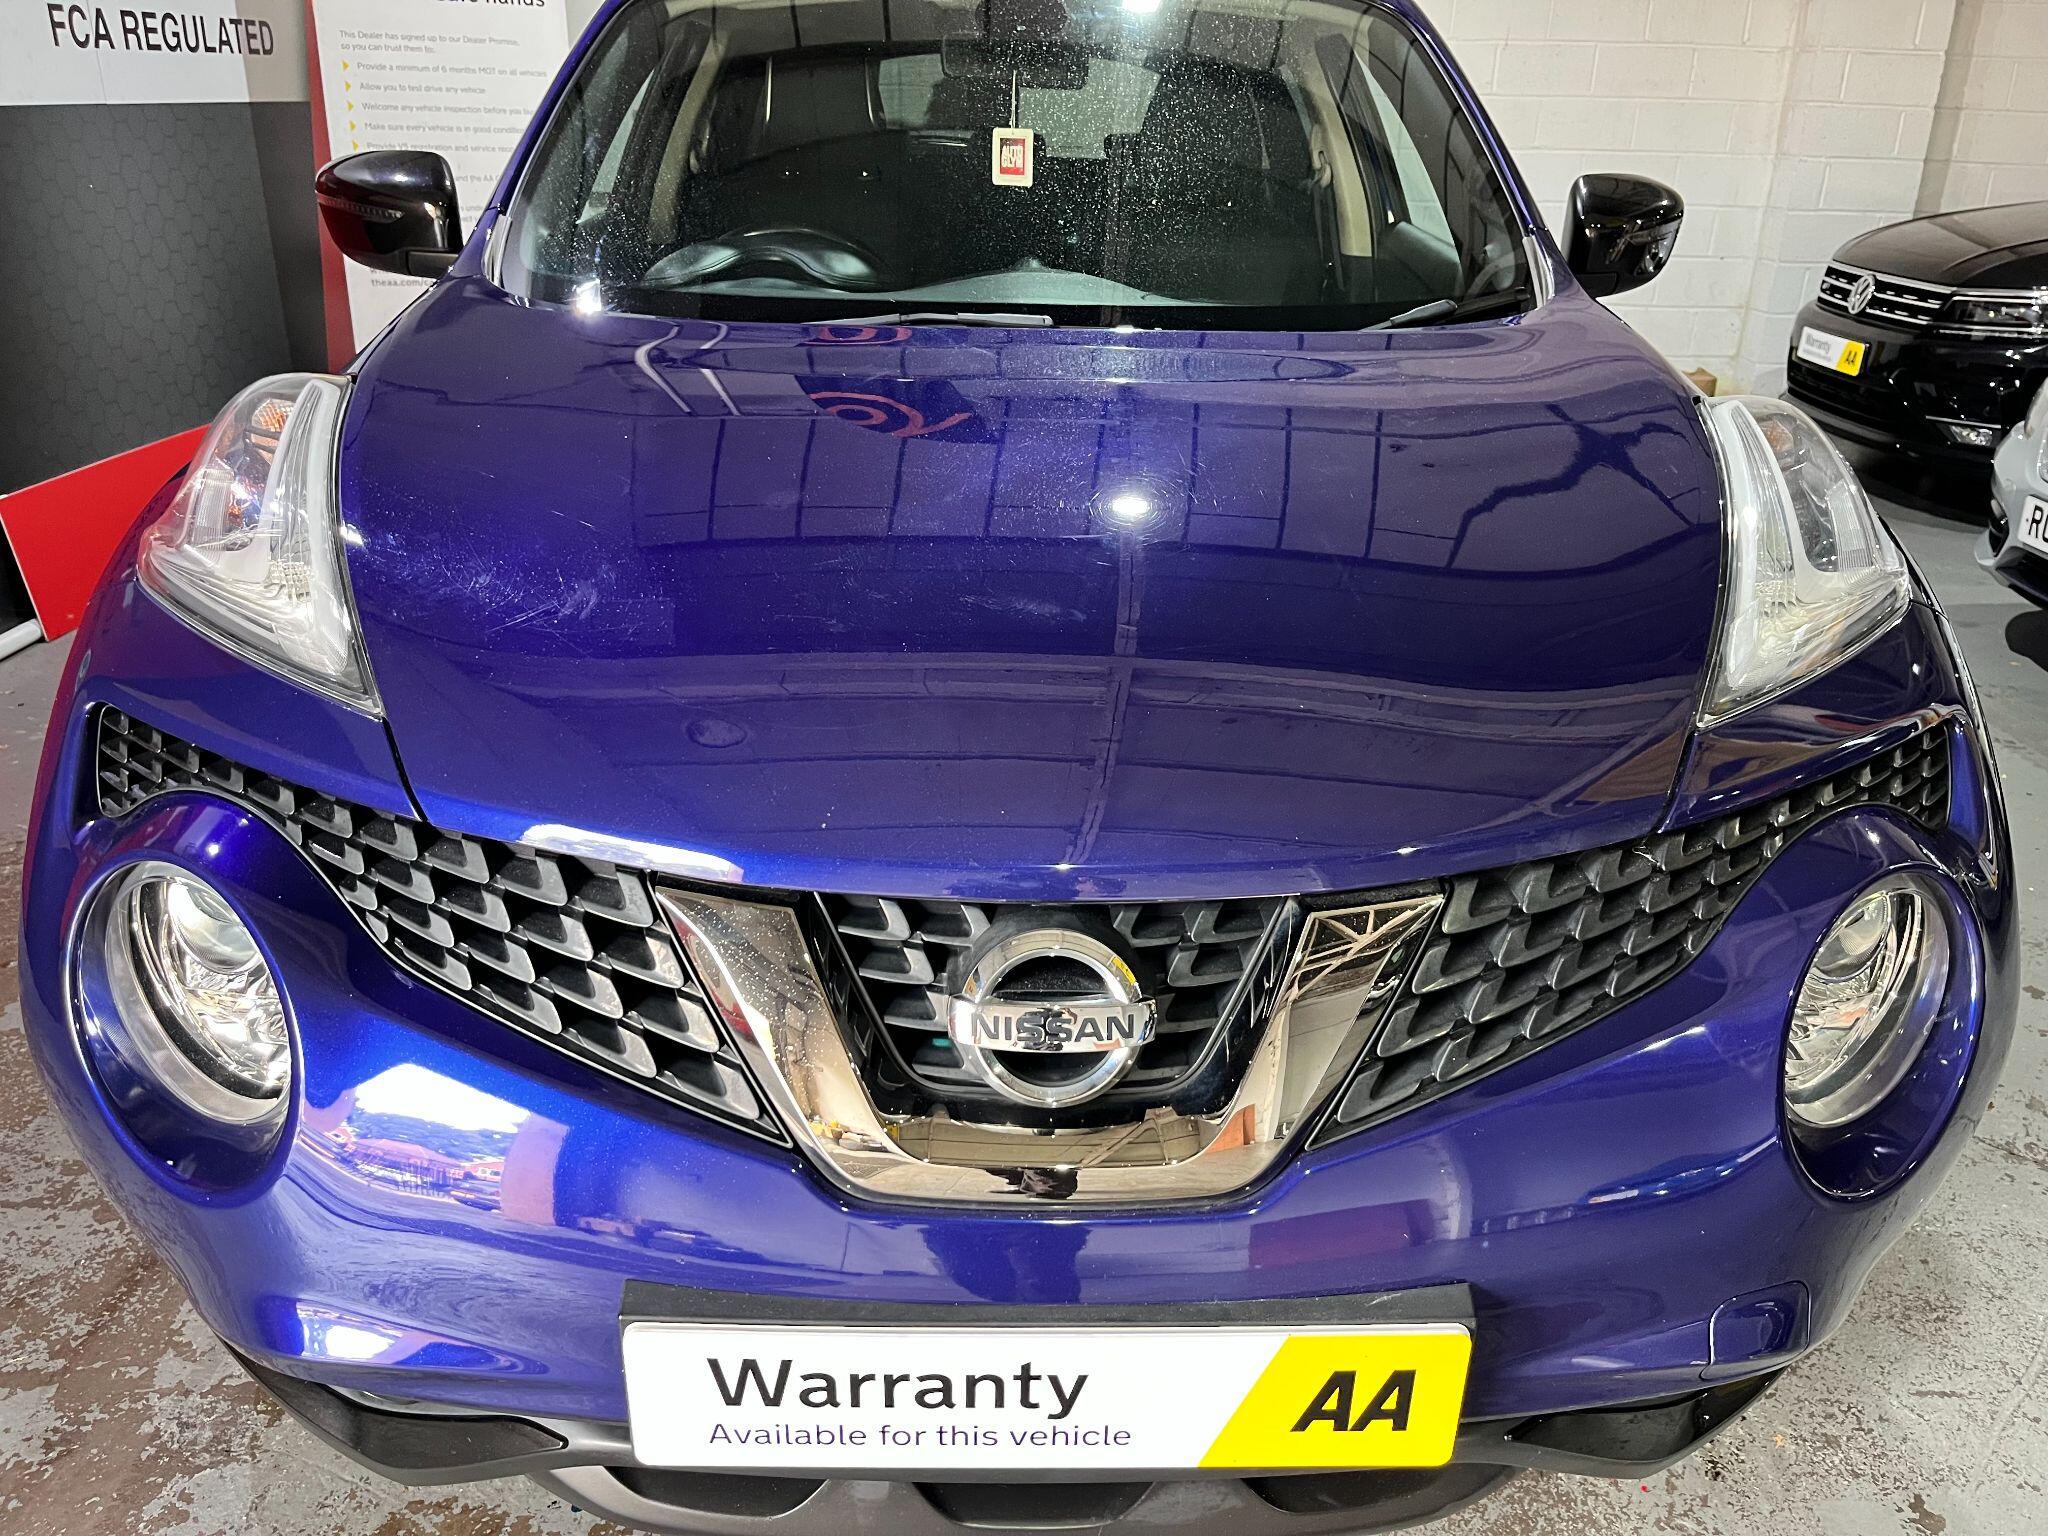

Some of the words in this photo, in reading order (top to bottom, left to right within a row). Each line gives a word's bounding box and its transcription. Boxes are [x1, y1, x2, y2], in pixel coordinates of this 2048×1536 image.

[47, 3, 115, 49] FCA
[120, 10, 274, 55] REGULATED
[339, 30, 356, 39] This
[357, 30, 383, 40] Dealer
[384, 32, 399, 40] has
[400, 33, 425, 42] signed
[352, 44, 367, 52] you
[368, 43, 383, 51] can
[384, 44, 402, 52] trust
[403, 44, 423, 52] them
[357, 62, 387, 71] Provide
[395, 64, 430, 72] minimum
[360, 82, 382, 91] Allow
[383, 84, 397, 92] you
[399, 83, 407, 91] to
[423, 84, 444, 92] drive
[445, 86, 459, 94] any
[362, 102, 399, 112] Welcome
[400, 104, 414, 113] any
[414, 104, 442, 112] vehicle
[443, 105, 483, 114] inspection
[364, 122, 386, 131] Make
[387, 124, 404, 132] sure
[406, 124, 426, 133] every
[971, 1014, 1134, 1043] NISSAN
[706, 1357, 1089, 1420] Warranty
[1289, 1369, 1417, 1432] AA
[709, 1424, 867, 1446] Available
[879, 1424, 926, 1446] for
[937, 1424, 998, 1446] this
[1010, 1424, 1131, 1446] vehicle
